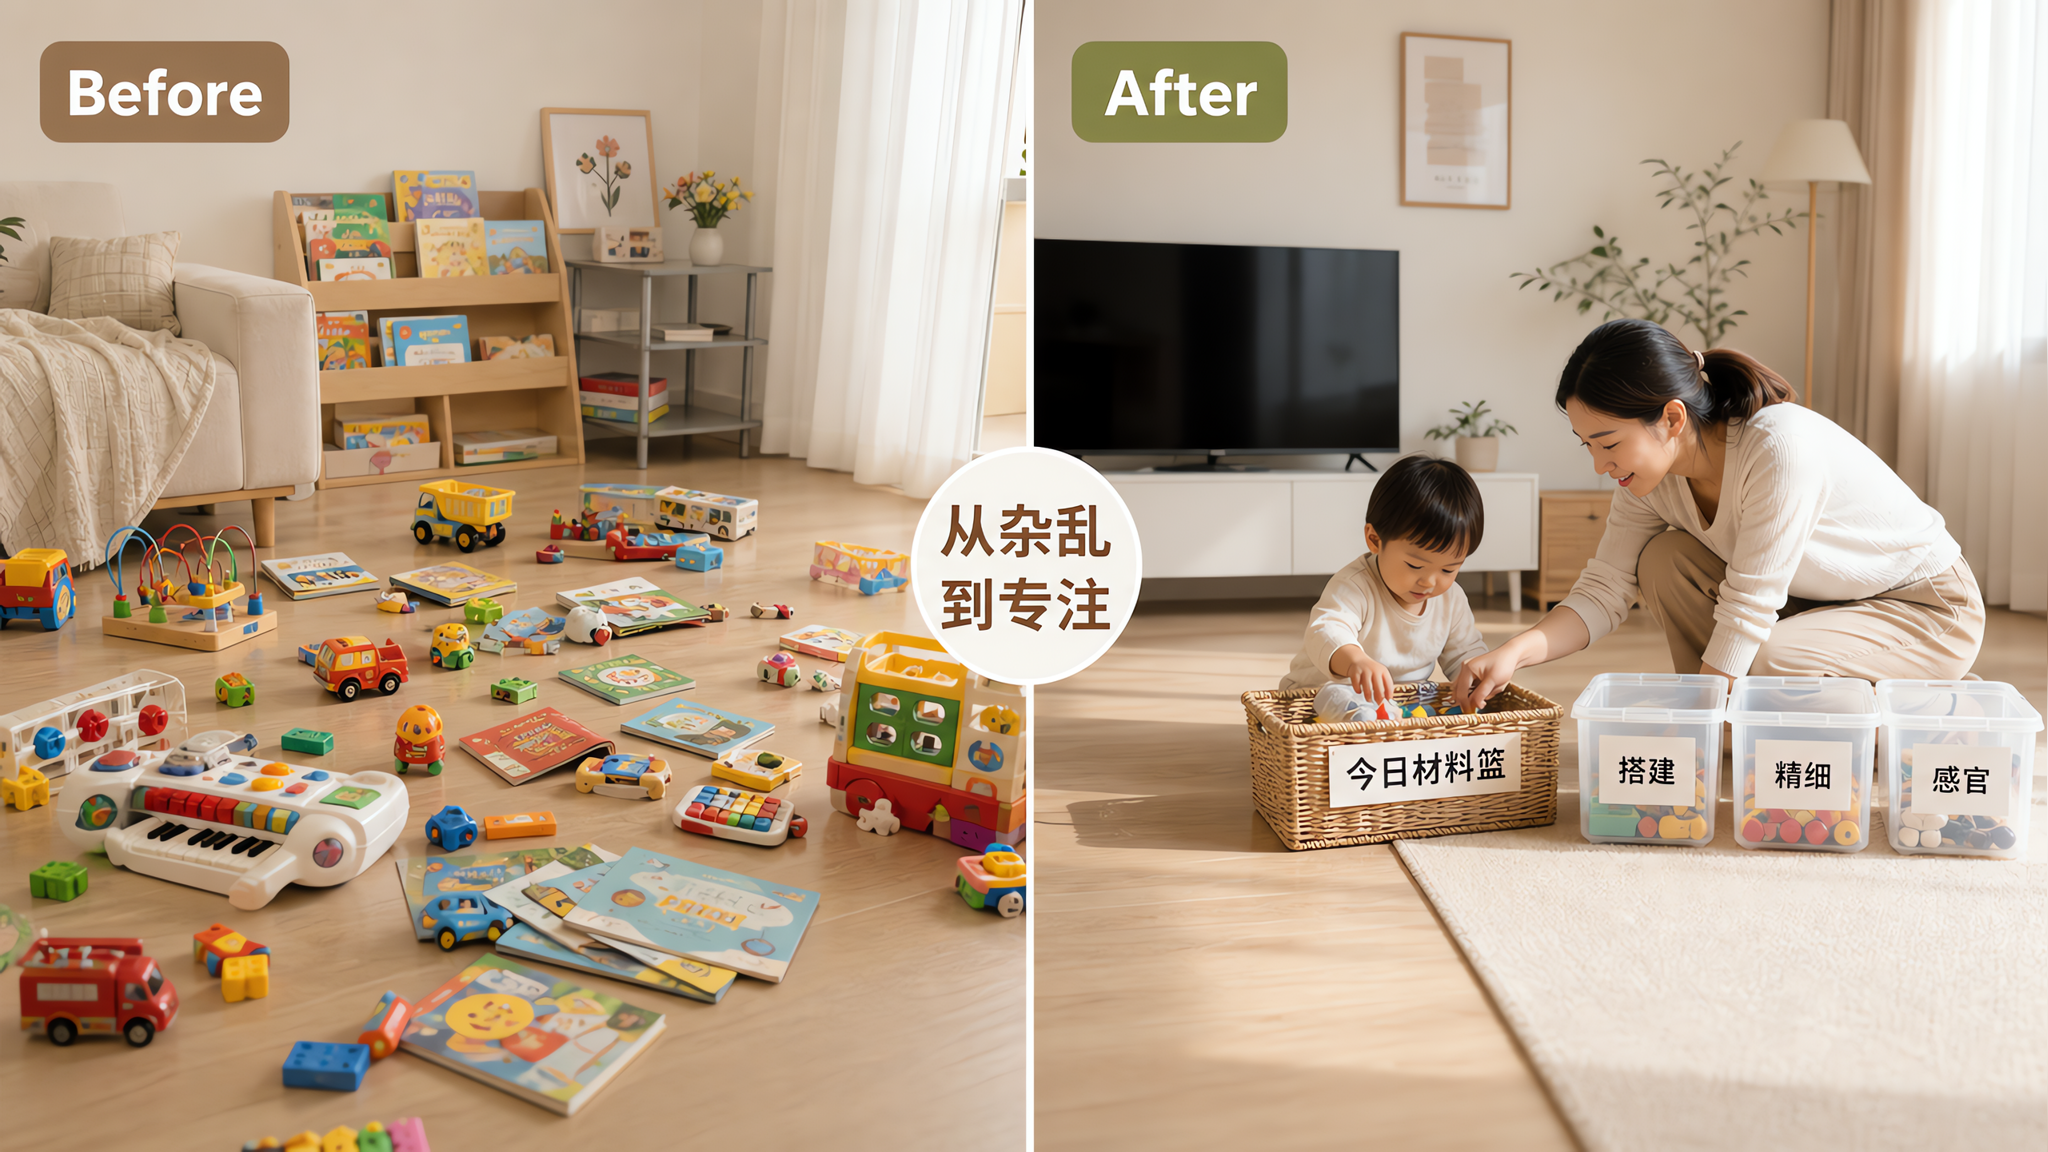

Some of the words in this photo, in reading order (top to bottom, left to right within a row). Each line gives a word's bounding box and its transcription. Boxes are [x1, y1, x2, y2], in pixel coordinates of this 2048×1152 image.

[1346, 747, 1506, 791] 今日材料篮
[1618, 755, 1676, 786] 搭建
[1774, 760, 1832, 790] 精细
[1932, 765, 1990, 795] 感官
